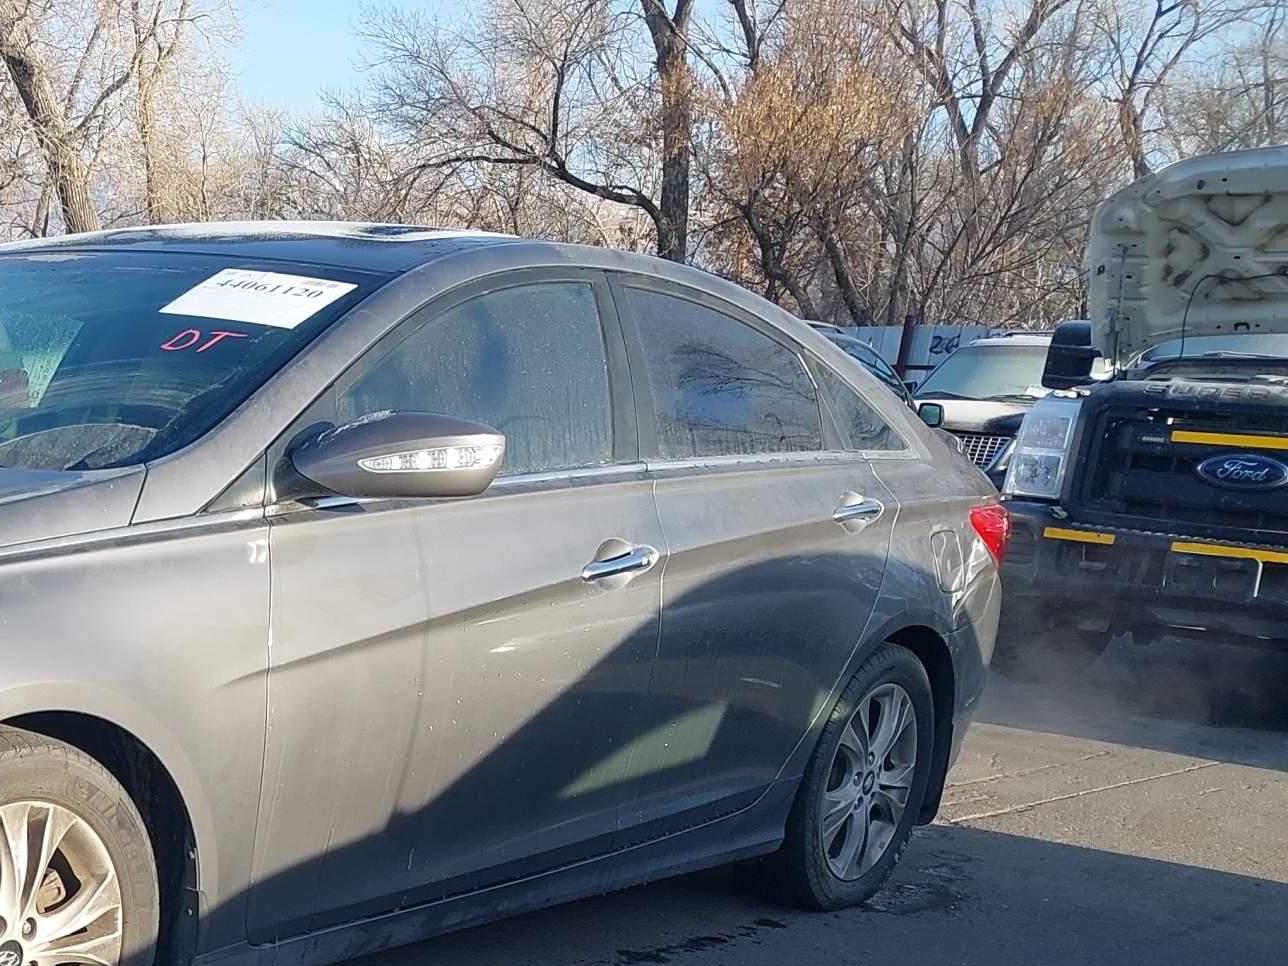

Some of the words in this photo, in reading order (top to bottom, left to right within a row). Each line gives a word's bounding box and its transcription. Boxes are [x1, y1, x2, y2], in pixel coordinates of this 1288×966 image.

[216, 279, 324, 299] 44061120
[159, 328, 249, 353] DT
[1143, 382, 1271, 399] SUPER
[1216, 459, 1271, 481] Ford
